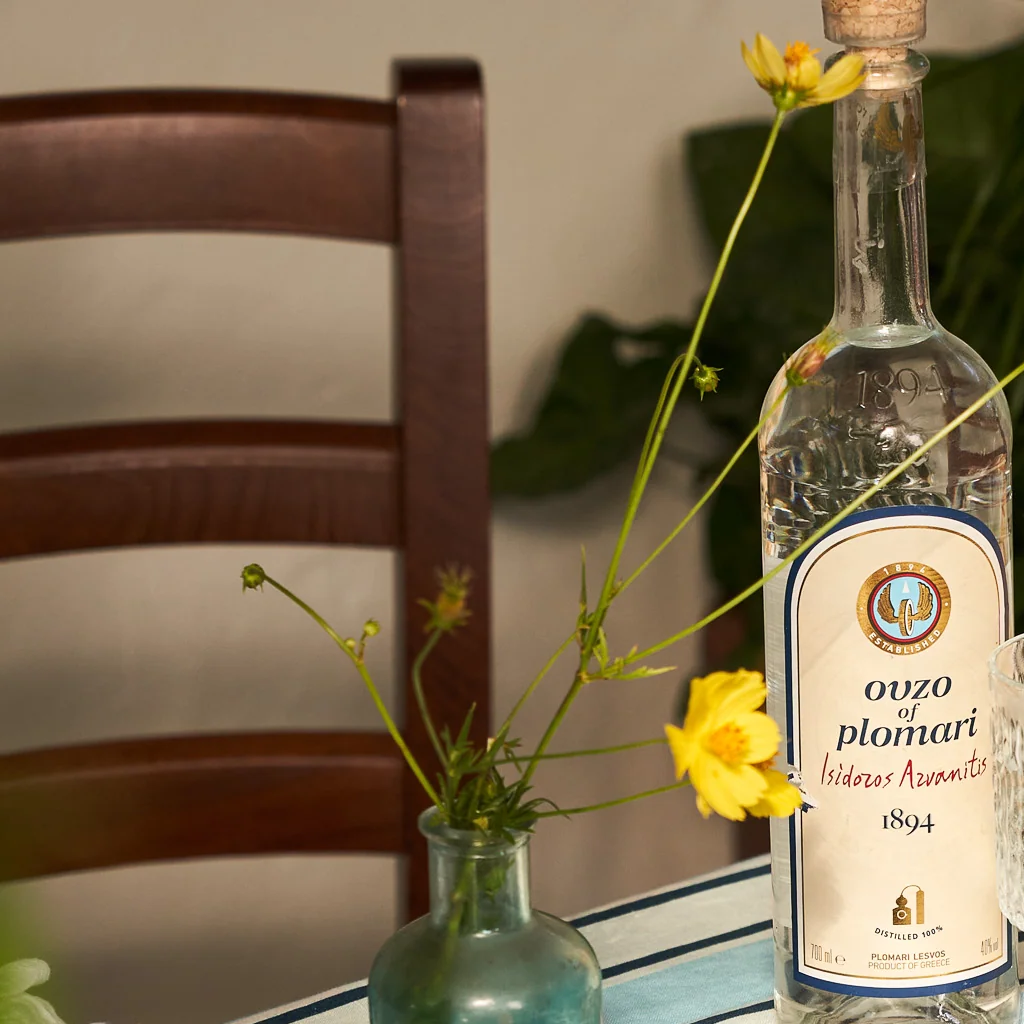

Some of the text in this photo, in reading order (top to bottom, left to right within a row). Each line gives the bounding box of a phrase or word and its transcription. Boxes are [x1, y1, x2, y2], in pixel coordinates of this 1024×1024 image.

[857, 364, 949, 410] 1894
[883, 563, 926, 575] 1894
[868, 630, 941, 654] ESTABLISHED
[898, 703, 920, 722] of
[836, 708, 978, 751] plomari
[882, 808, 935, 836] 1894
[874, 924, 944, 941] DISTILLED 100%
[810, 943, 823, 961] 700
[824, 948, 833, 964] ml
[871, 949, 946, 961] PLOMARI LESVOS
[868, 959, 951, 970] PRODUCT OF GREECE
